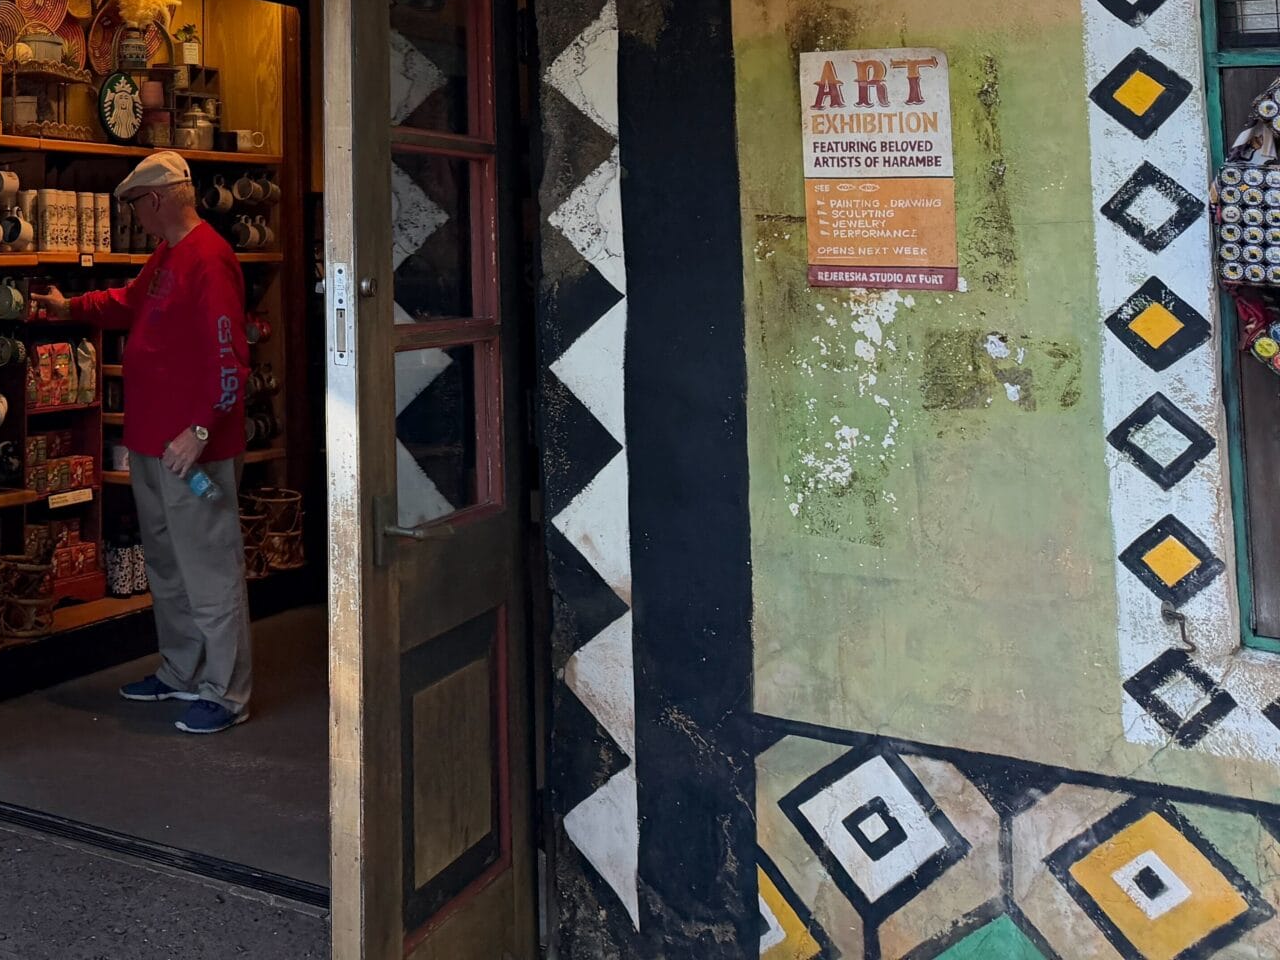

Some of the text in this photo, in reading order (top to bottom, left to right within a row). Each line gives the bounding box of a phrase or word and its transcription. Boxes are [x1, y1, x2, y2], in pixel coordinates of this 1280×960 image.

[810, 56, 939, 110] ART
[811, 111, 939, 135] EXHIBITION
[813, 140, 933, 153] FEATURING BELOVED
[814, 155, 942, 168] ARTISTS OF HARAMBE
[814, 184, 830, 193] SEE
[830, 199, 880, 208] PAINTING
[890, 198, 942, 208] DRAWING
[832, 209, 895, 219] SCULPTING
[832, 219, 886, 229] JEWELRY
[833, 229, 918, 238] PERFORMANCE
[817, 246, 928, 256] OPENS NEXT WEEK
[869, 272, 904, 283] STUDIO
[906, 273, 917, 284] AT
